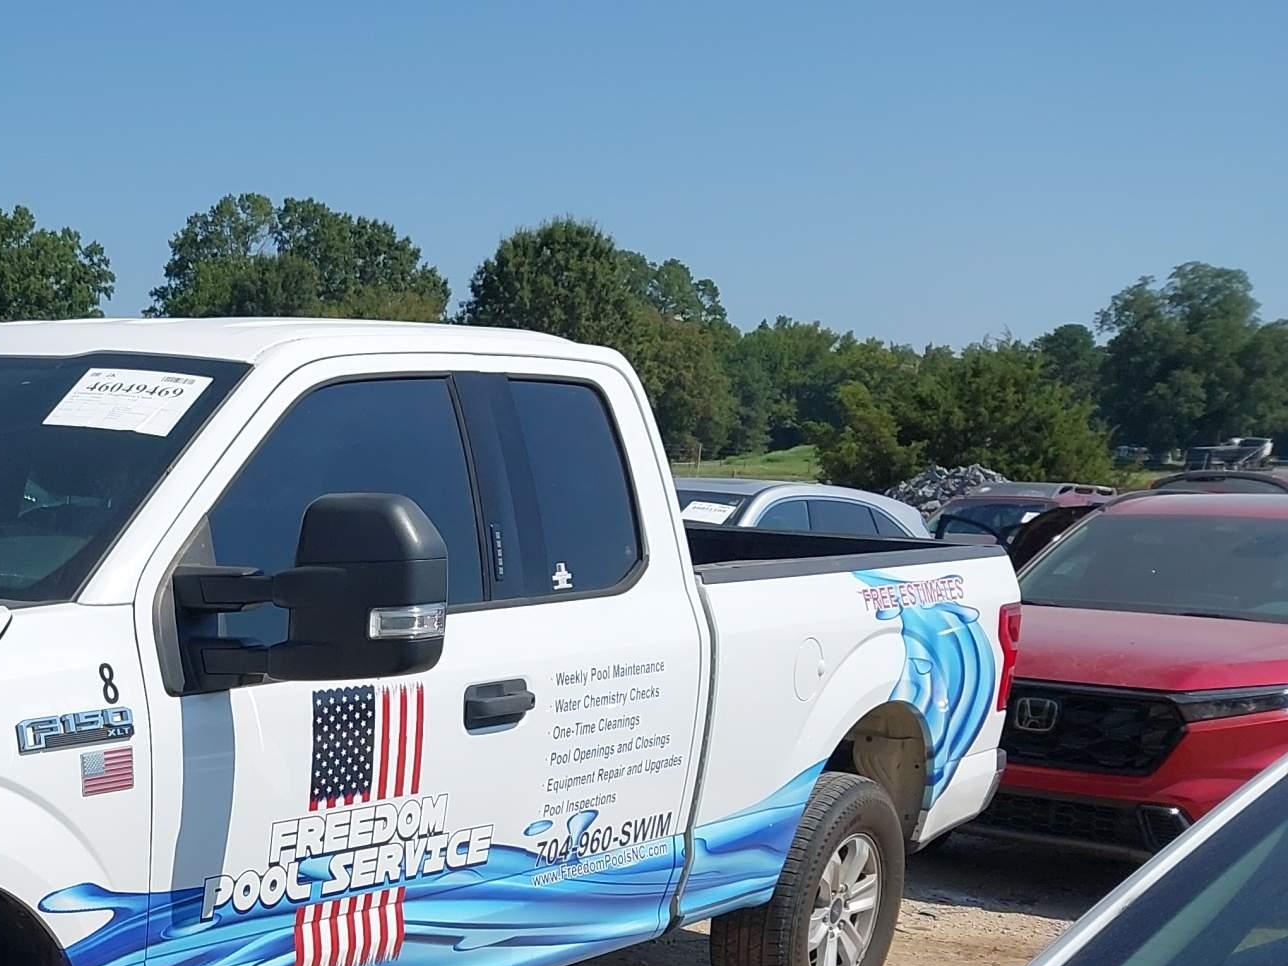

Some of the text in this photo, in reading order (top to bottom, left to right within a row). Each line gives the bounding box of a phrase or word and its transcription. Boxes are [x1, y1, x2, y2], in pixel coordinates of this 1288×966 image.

[86, 382, 184, 398] 46049469
[862, 579, 964, 611] FREE ESTIMATES
[99, 663, 119, 704] 8
[556, 661, 664, 686] Weekly Pool Maintenance
[555, 685, 660, 713] Water Chemistry Checks
[107, 727, 130, 737] XLT
[553, 715, 640, 739] One-Time Cleanings
[550, 733, 670, 766] Pool Openings and Closings
[547, 755, 682, 793] Equipment Repair and Upgrades
[543, 792, 617, 817] Pool Inspections
[269, 794, 448, 866] FREEDOM
[536, 812, 672, 867] 704-960-SWIM
[200, 824, 494, 923] POOL SERVICE
[533, 843, 668, 887] www.FreedomPoolsNC.com
